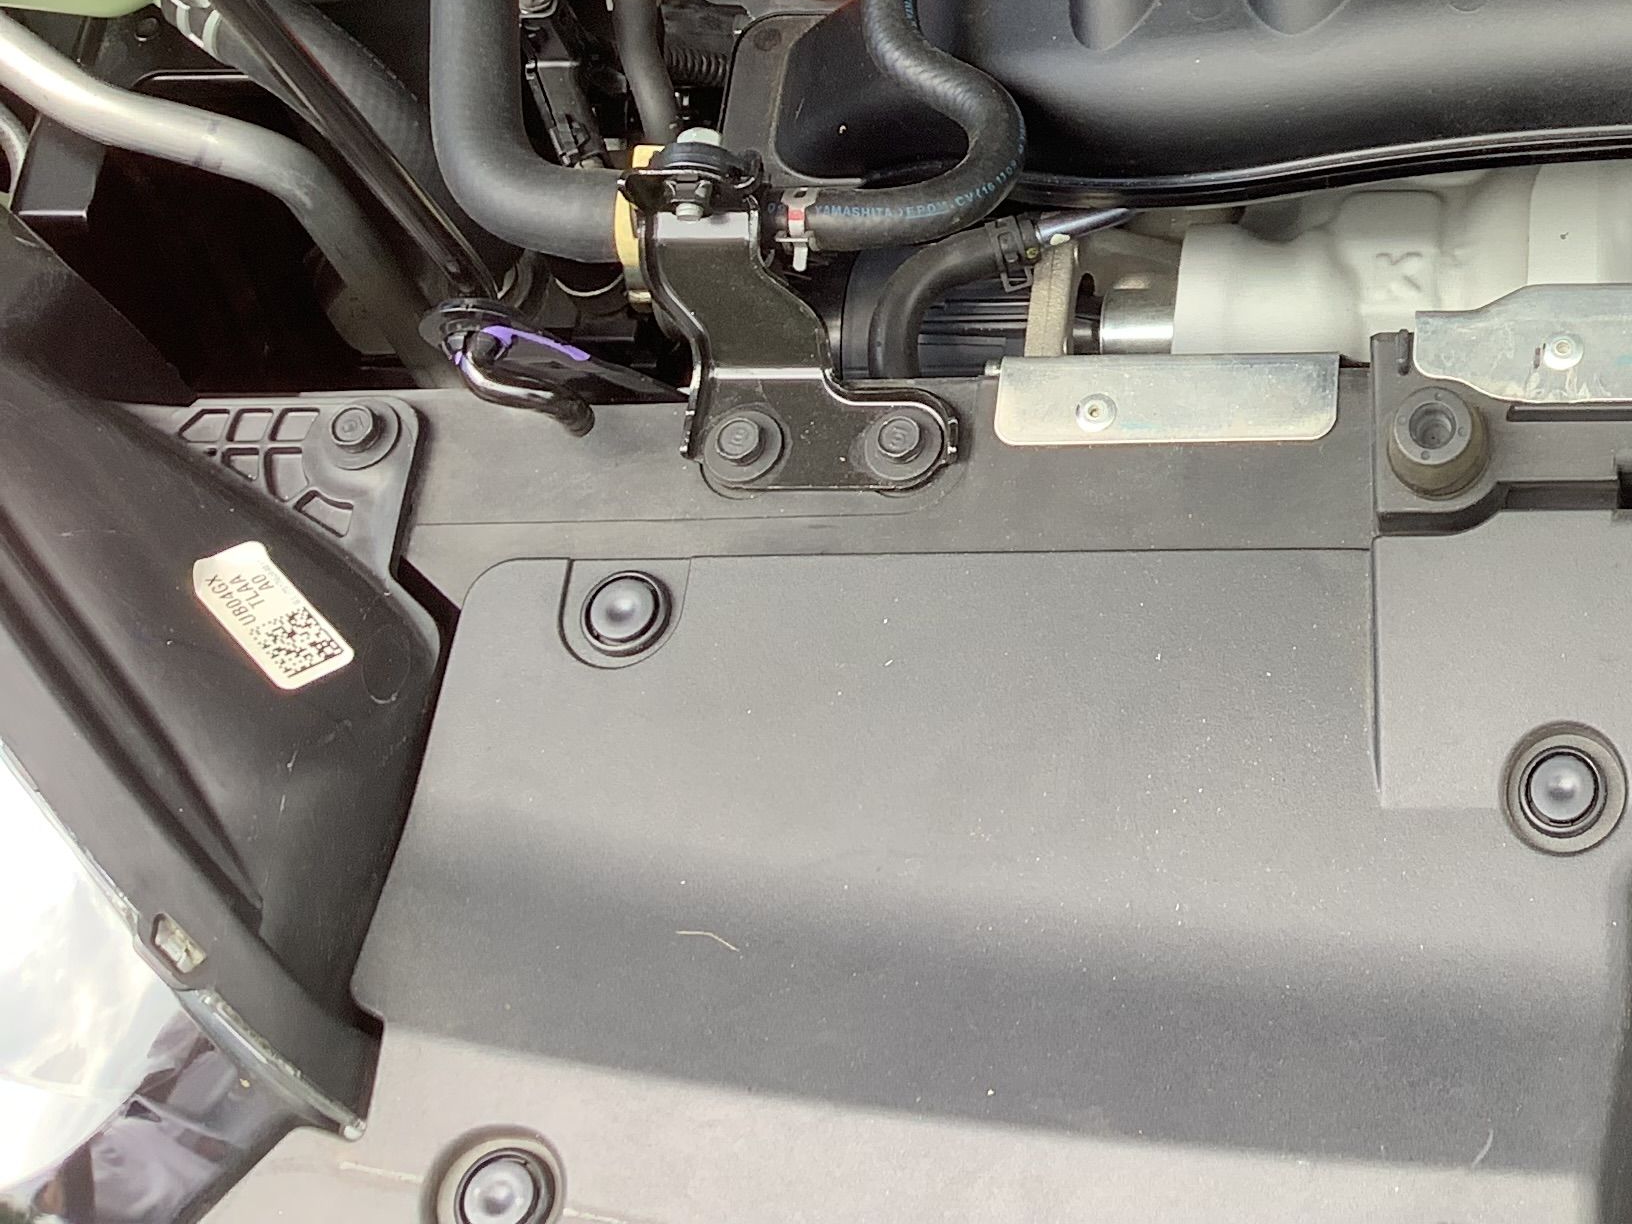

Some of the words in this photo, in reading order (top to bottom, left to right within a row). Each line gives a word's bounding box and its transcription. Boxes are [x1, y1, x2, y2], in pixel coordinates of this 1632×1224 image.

[814, 205, 893, 218] YAMASHITA
[205, 574, 257, 626] UB04GX
[229, 574, 265, 609] TLAA
